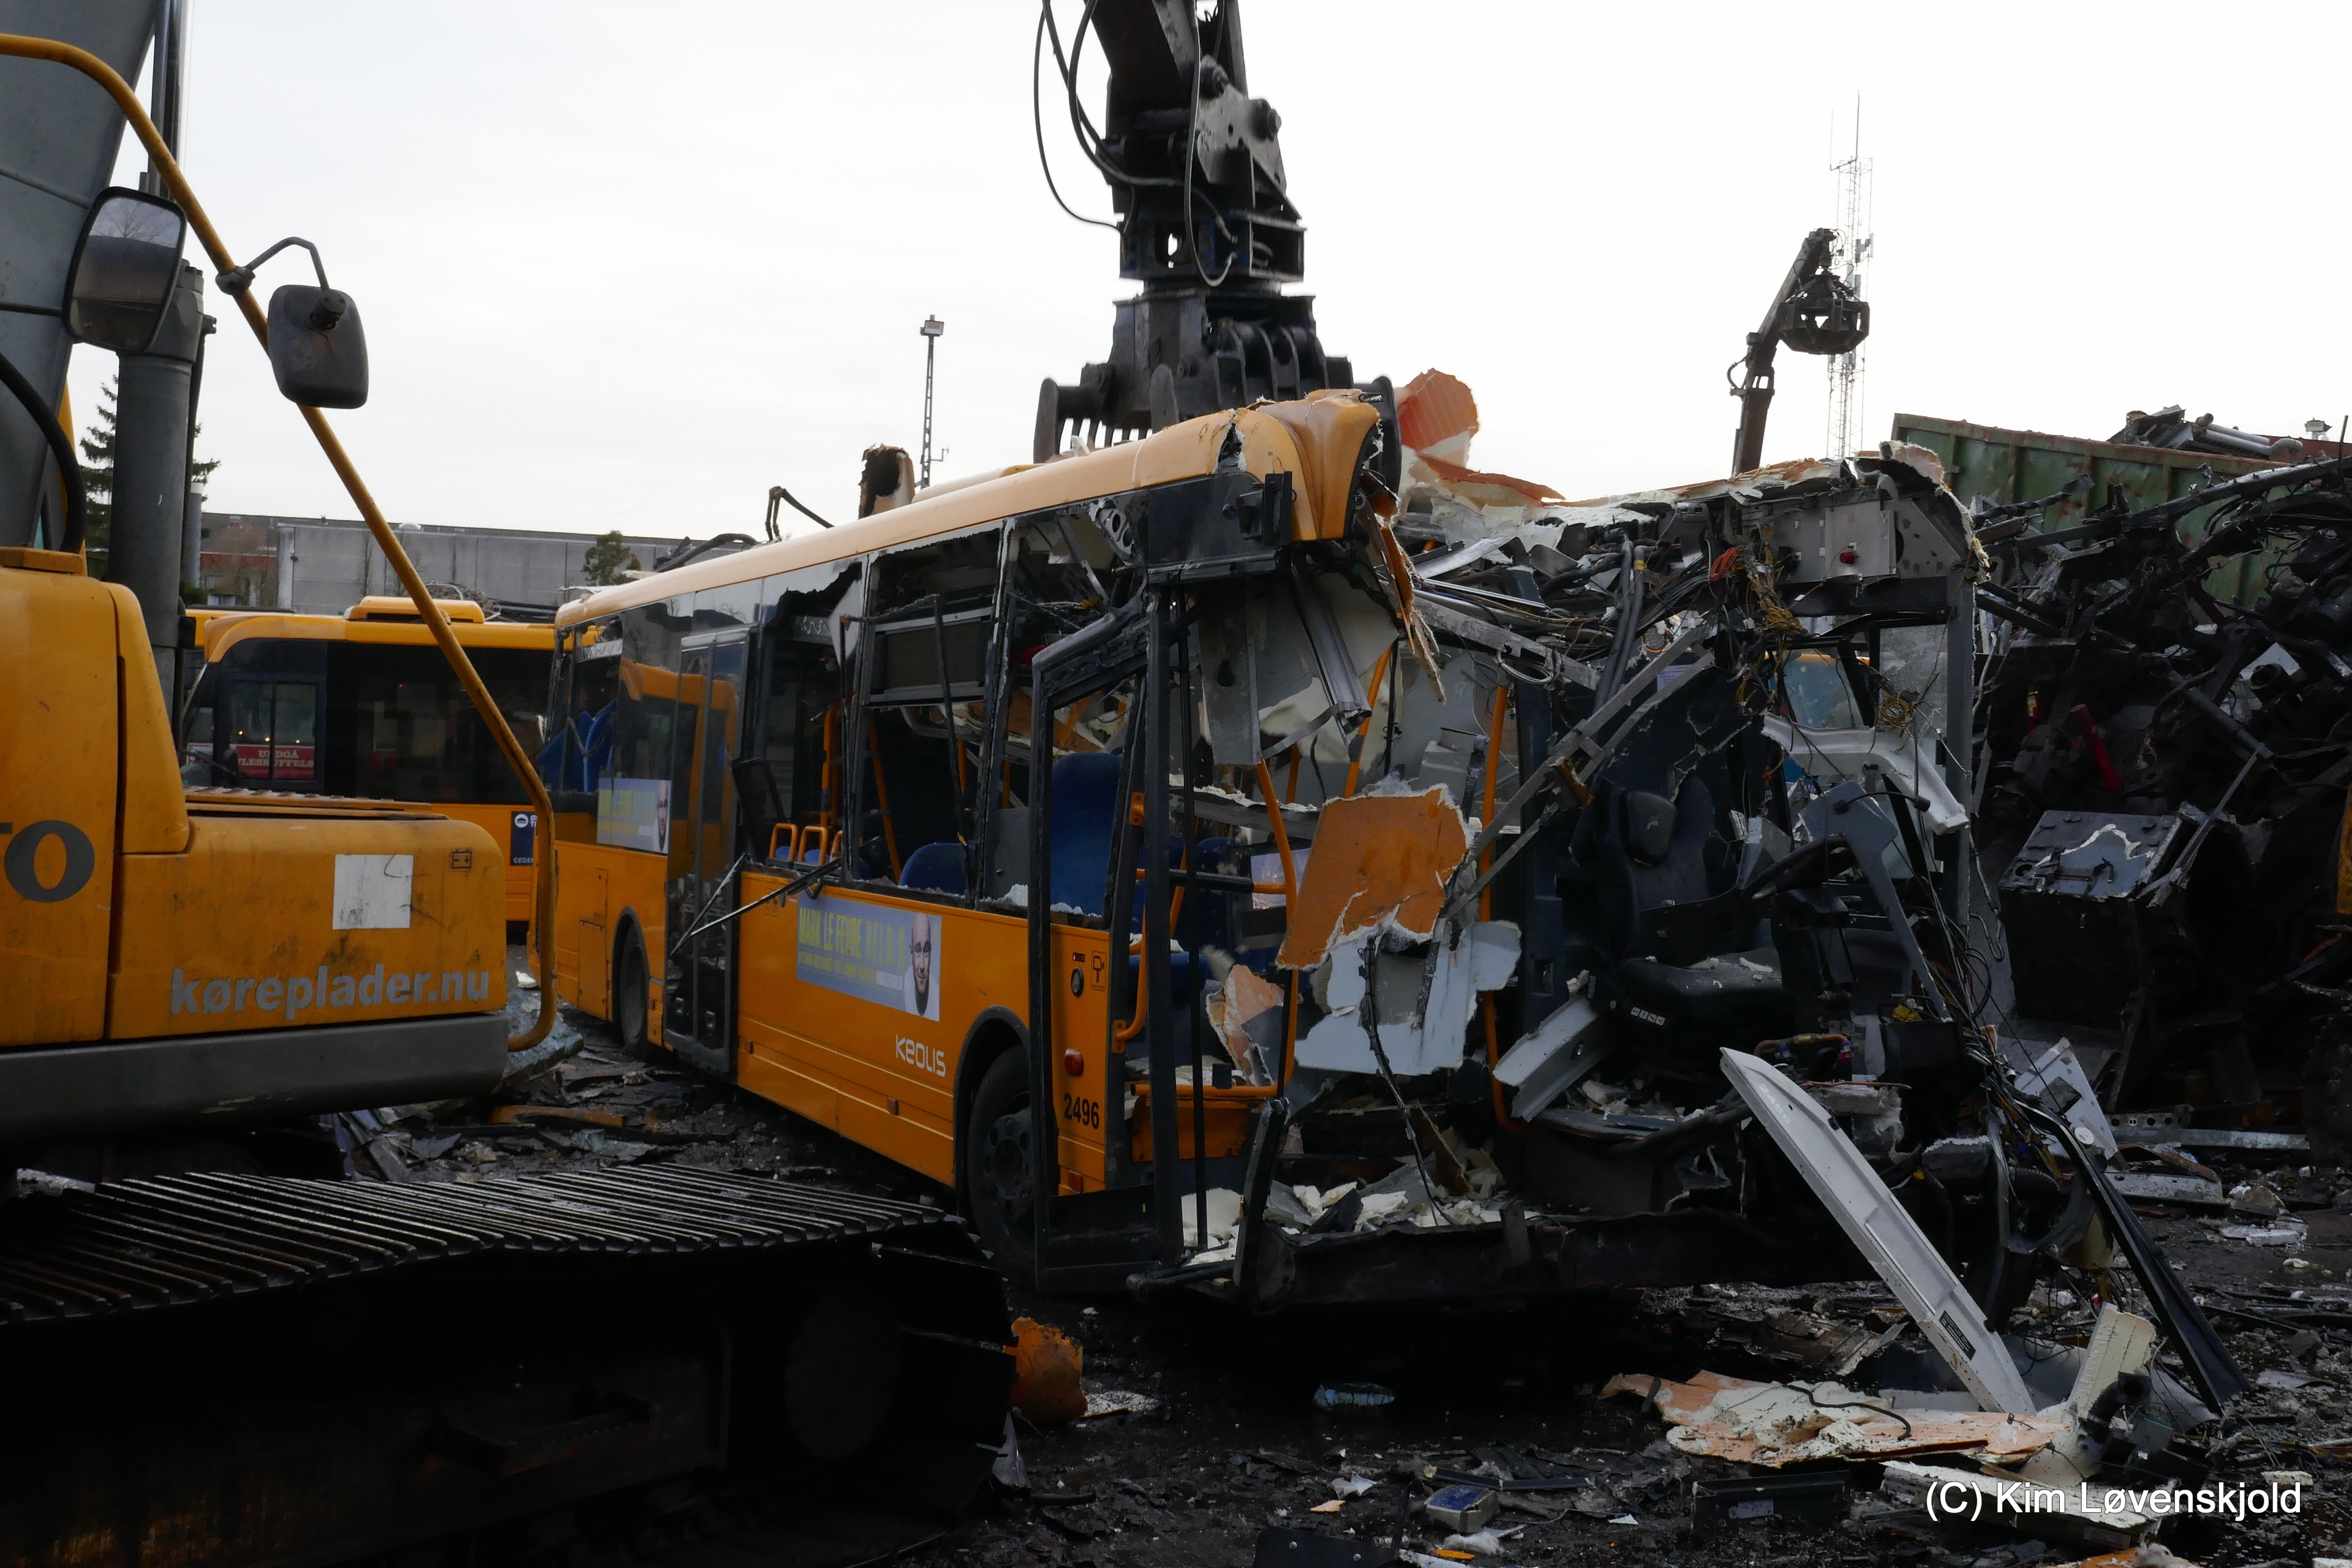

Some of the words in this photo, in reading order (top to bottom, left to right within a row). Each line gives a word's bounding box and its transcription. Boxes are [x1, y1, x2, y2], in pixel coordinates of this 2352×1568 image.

[0, 820, 95, 903] O
[170, 963, 489, 1020] køreplader.nu
[1063, 1092, 1100, 1130] 2496
